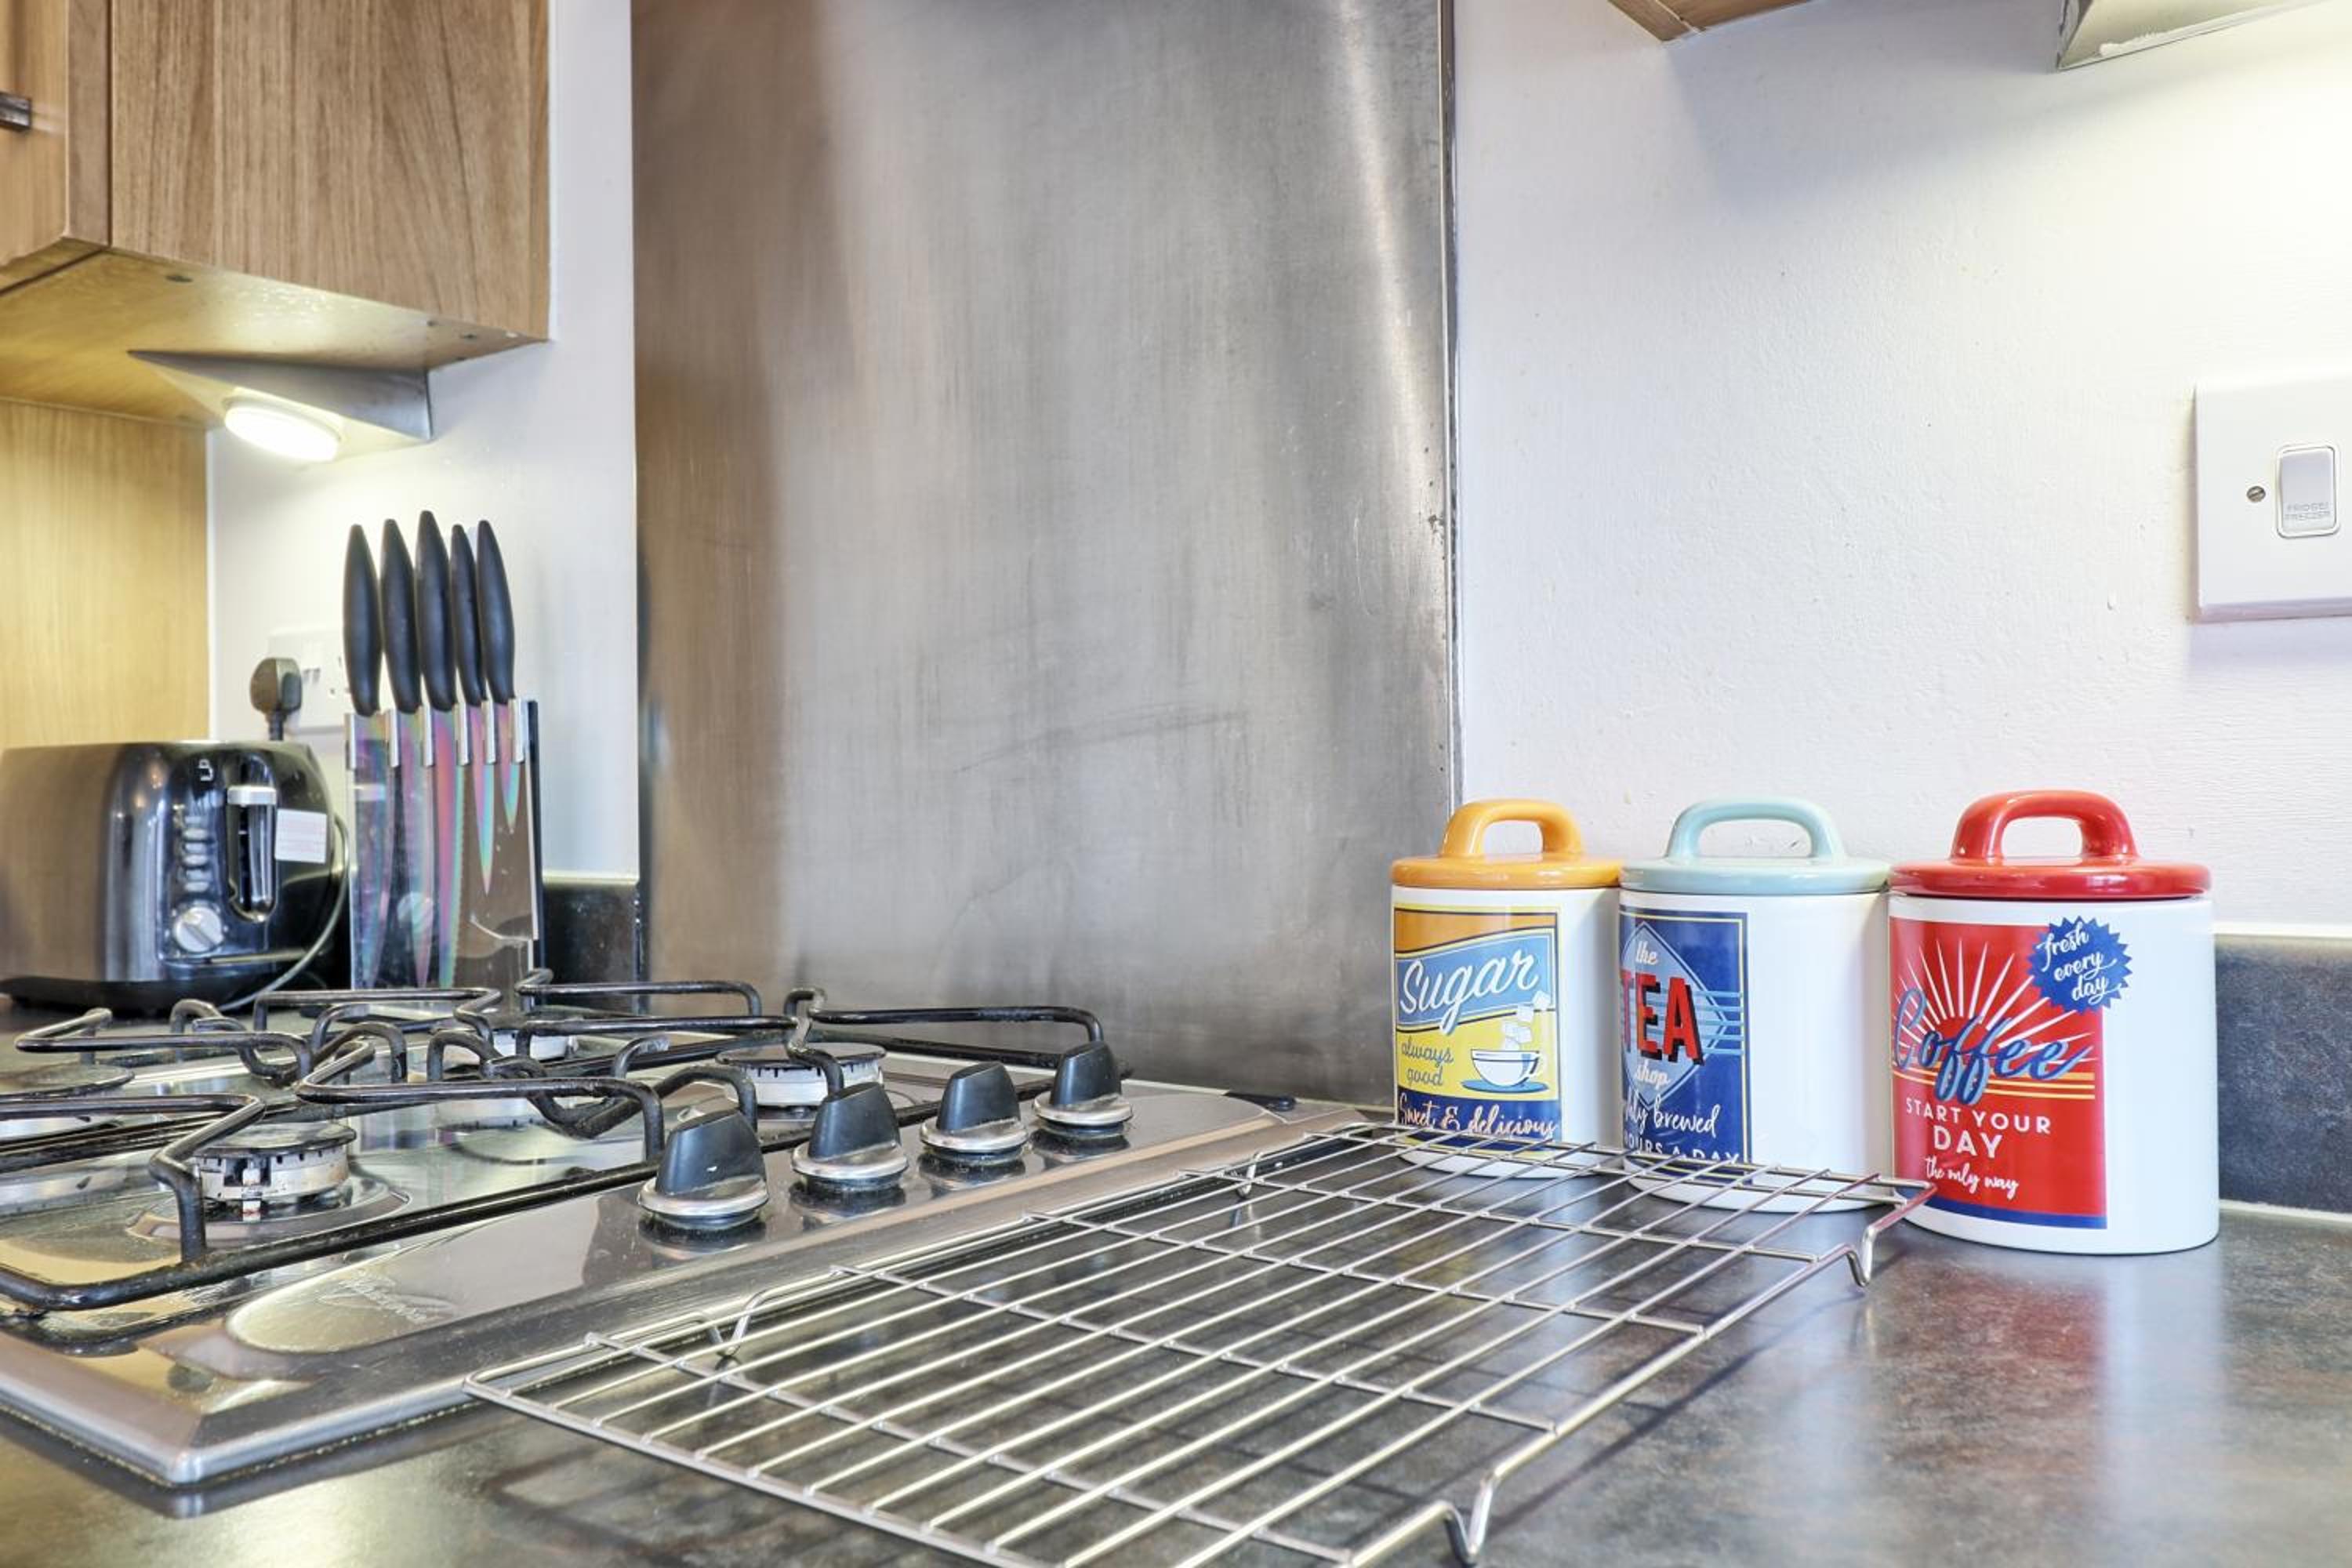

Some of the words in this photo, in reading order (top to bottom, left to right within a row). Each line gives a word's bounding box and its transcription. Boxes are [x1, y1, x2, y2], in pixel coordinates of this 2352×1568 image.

[1635, 941, 1658, 965] the
[2036, 921, 2089, 972] fresh
[2054, 952, 2117, 981] every
[1400, 949, 1539, 1034] Sugar
[2071, 975, 2122, 1005] day
[1621, 970, 1705, 1066] TEA
[1402, 1035, 1454, 1068] always
[1894, 988, 2094, 1105] Coffee
[1406, 1066, 1444, 1088] good
[1635, 1059, 1670, 1091] shop
[1441, 1106, 1461, 1131] &
[1468, 1104, 1557, 1139] delicious
[1653, 1093, 1721, 1139] brewed
[1906, 1098, 1961, 1123] START
[1972, 1109, 2051, 1134] YOUR
[1933, 1124, 2002, 1159] DAY
[1924, 1156, 1944, 1179] the
[1947, 1162, 1980, 1194] only
[1984, 1176, 2019, 1200] way
